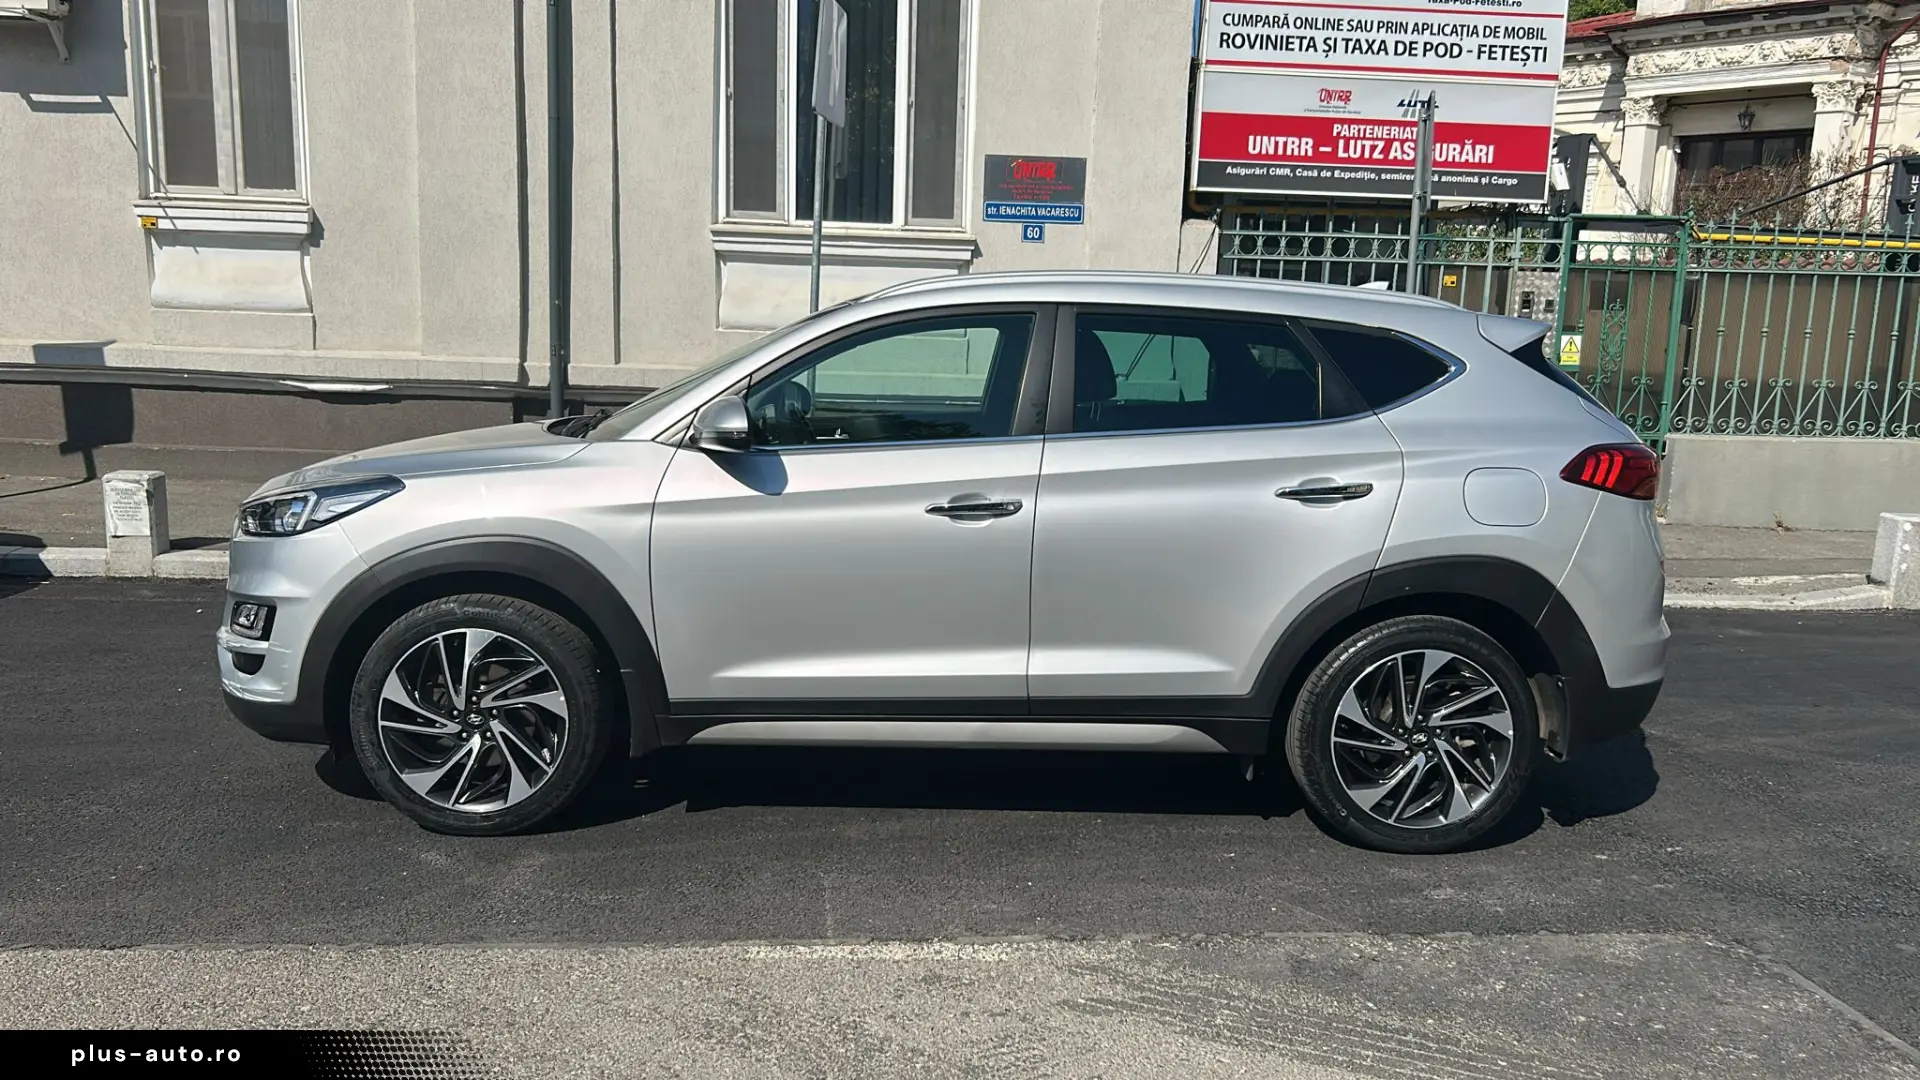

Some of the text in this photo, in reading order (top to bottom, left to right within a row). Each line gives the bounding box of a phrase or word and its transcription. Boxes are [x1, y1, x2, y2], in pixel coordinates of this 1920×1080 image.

[1222, 13, 1547, 41] CUMPARĂ ONLINE SAU PRIN APLICAȚIA DE MOBIL
[1219, 32, 1318, 53] ROVINIETA
[1341, 38, 1389, 56] TAXA
[1393, 40, 1418, 57] DE
[1422, 42, 1463, 59] POD
[1333, 124, 1418, 140] PARTENERIAT
[1248, 135, 1314, 157] UNTRR
[1337, 139, 1384, 160] LUTZ
[1388, 139, 1495, 164] ASURĂRI
[1225, 166, 1267, 176] Asigurări
[1269, 167, 1293, 177] CMR,
[1320, 170, 1332, 178] de
[1491, 175, 1518, 186] Cargo
[987, 205, 1080, 218] str. IENACHITA VACARESCU
[1027, 227, 1040, 239] 60
